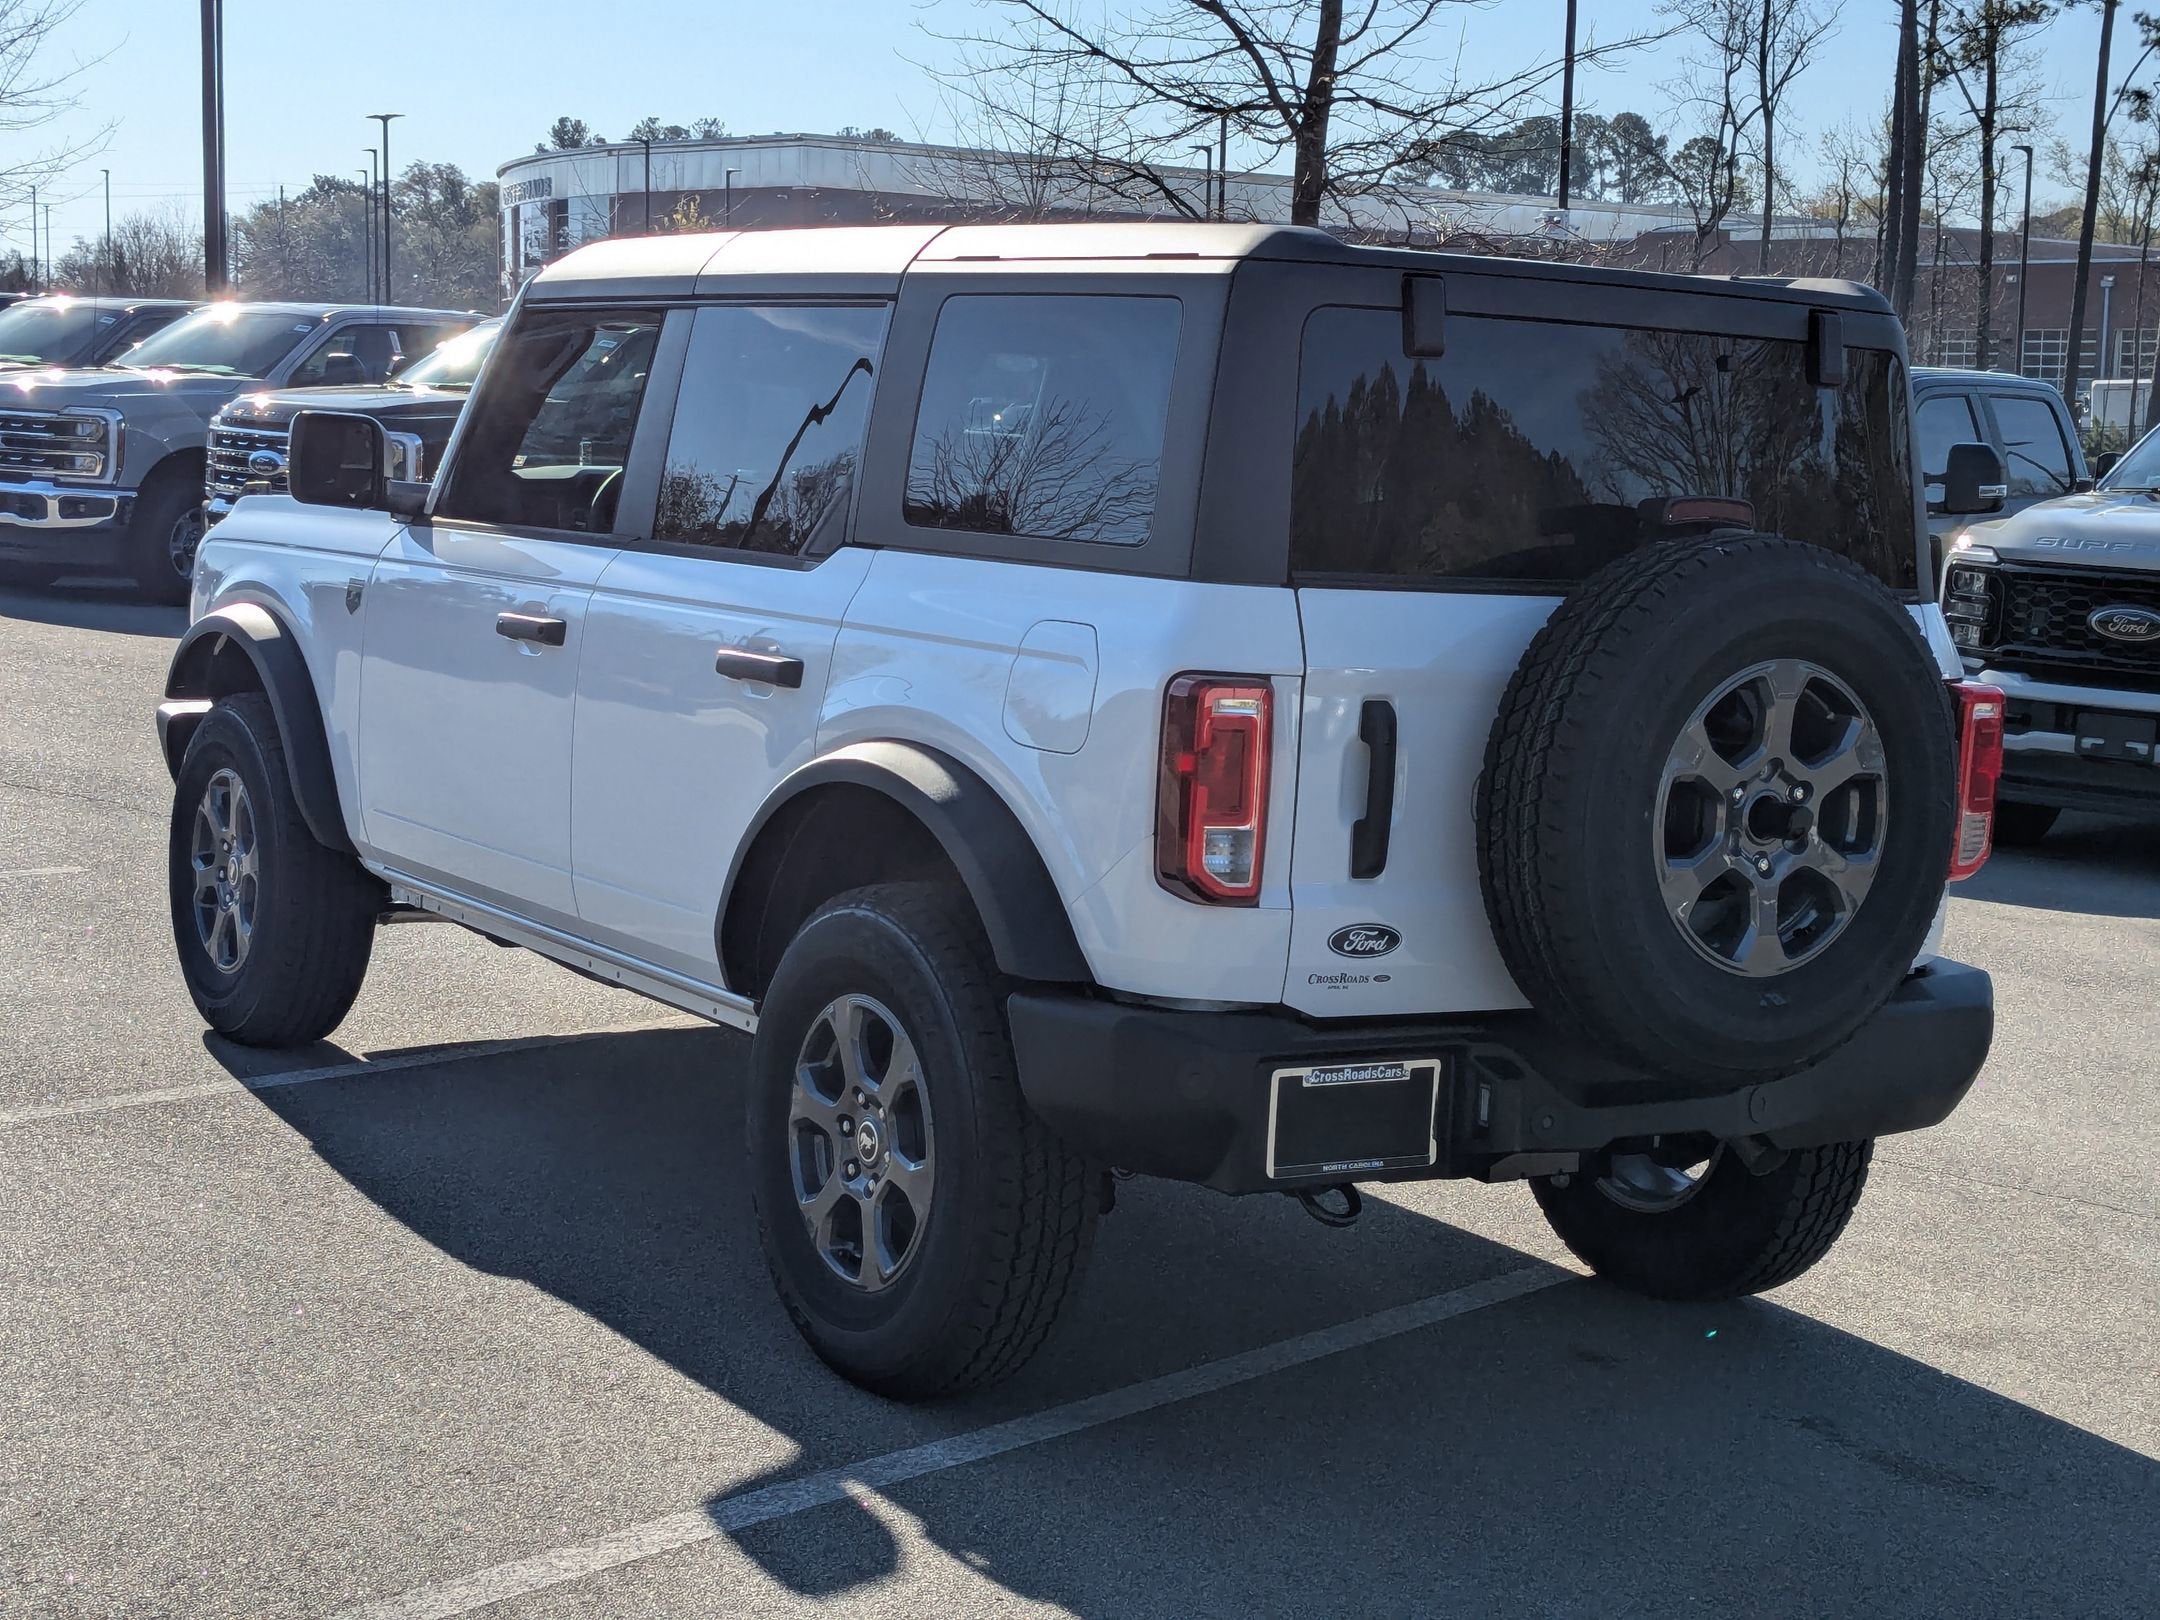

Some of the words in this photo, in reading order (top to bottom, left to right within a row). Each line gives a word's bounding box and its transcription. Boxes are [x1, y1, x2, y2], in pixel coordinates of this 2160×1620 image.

[2108, 615, 2150, 634] Ford
[1343, 930, 1389, 951] Ford
[1323, 1163, 1347, 1172] NORTH
[1348, 1161, 1384, 1169] CAROLINA
